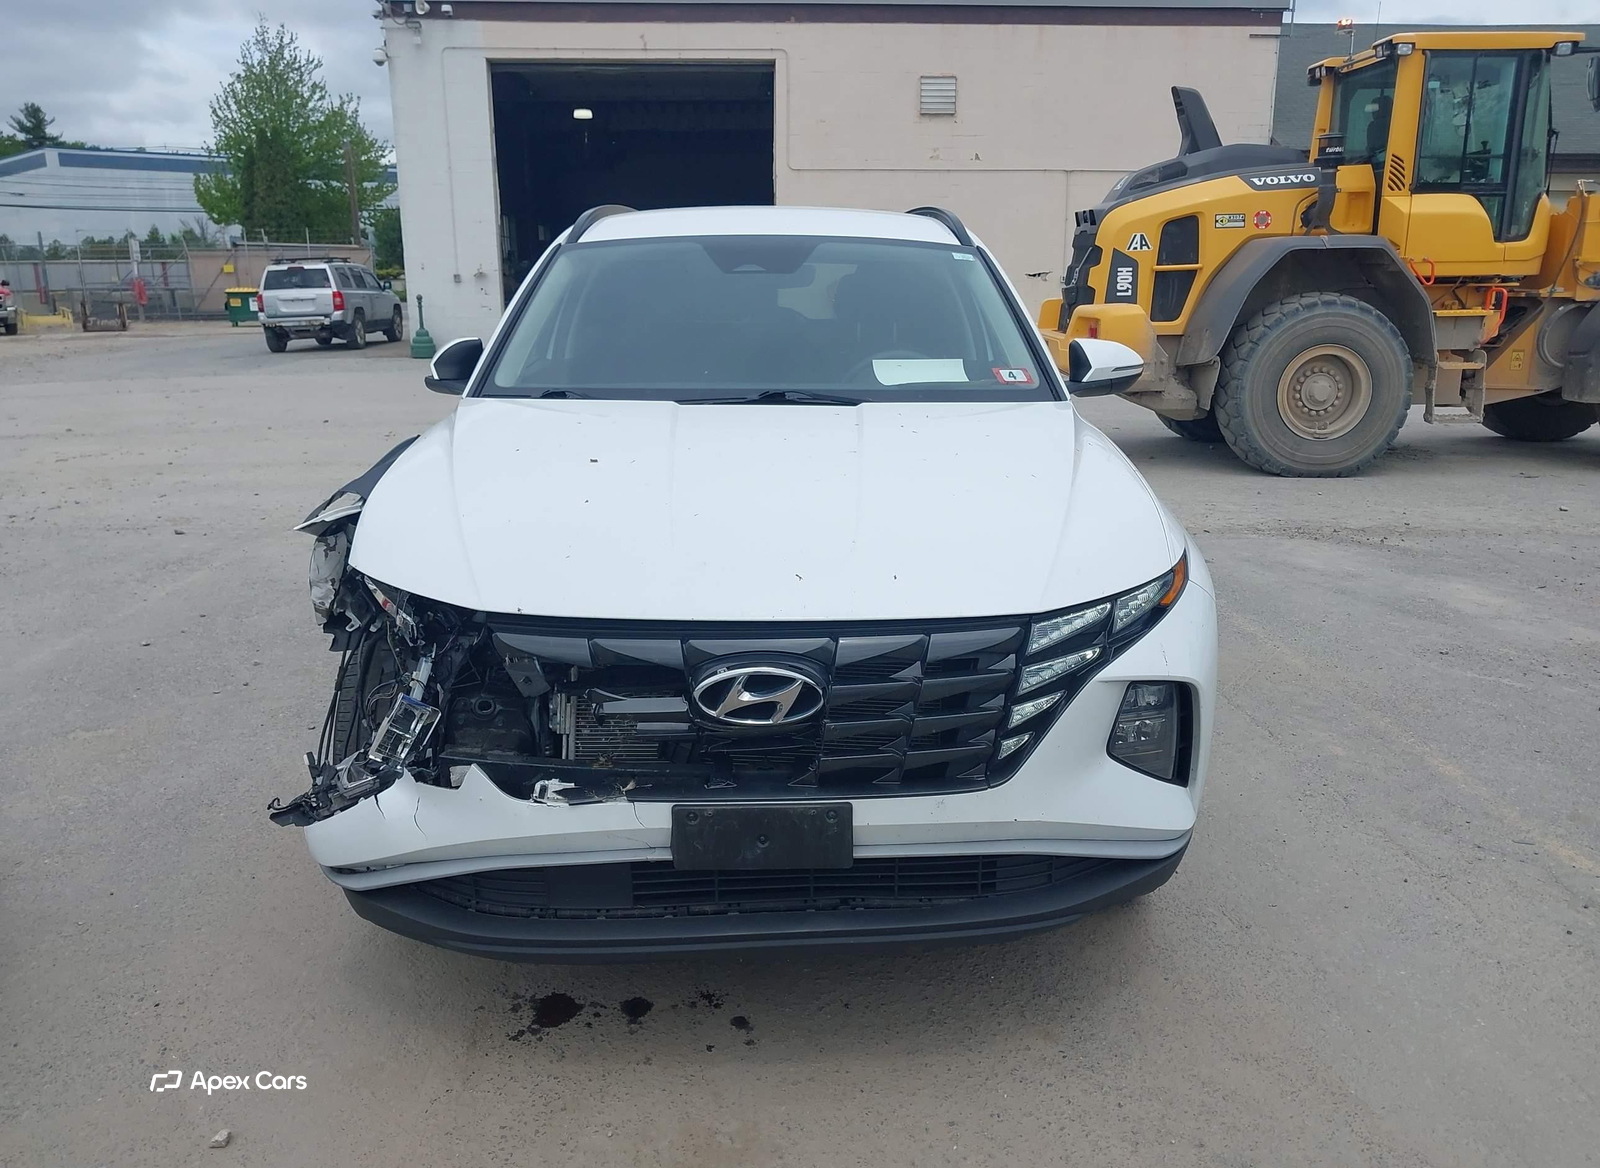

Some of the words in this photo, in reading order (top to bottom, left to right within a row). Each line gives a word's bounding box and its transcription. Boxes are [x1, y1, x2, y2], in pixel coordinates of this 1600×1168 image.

[1250, 173, 1316, 186] VOLVO
[1116, 267, 1133, 296] L90H
[1008, 371, 1017, 380] 4
